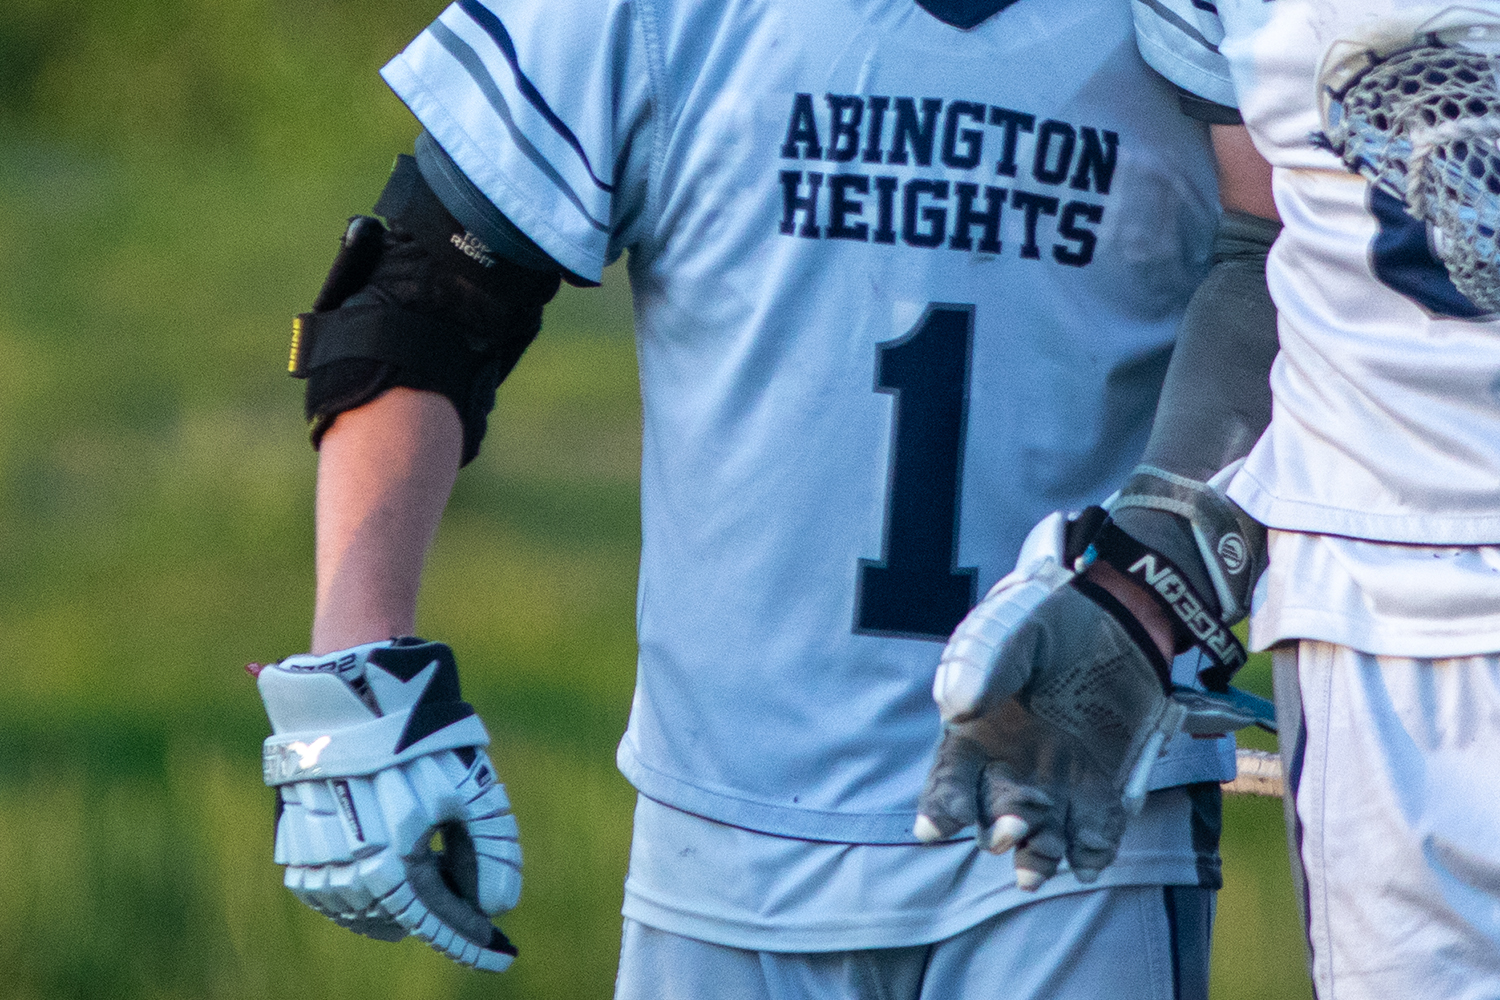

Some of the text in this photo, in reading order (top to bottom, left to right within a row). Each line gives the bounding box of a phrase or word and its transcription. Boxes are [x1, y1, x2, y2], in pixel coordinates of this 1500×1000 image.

[779, 92, 1120, 195] ABINGTON
[450, 233, 495, 268] RIGHT
[778, 169, 1105, 268] HEIGHTS
[851, 300, 979, 645] 1
